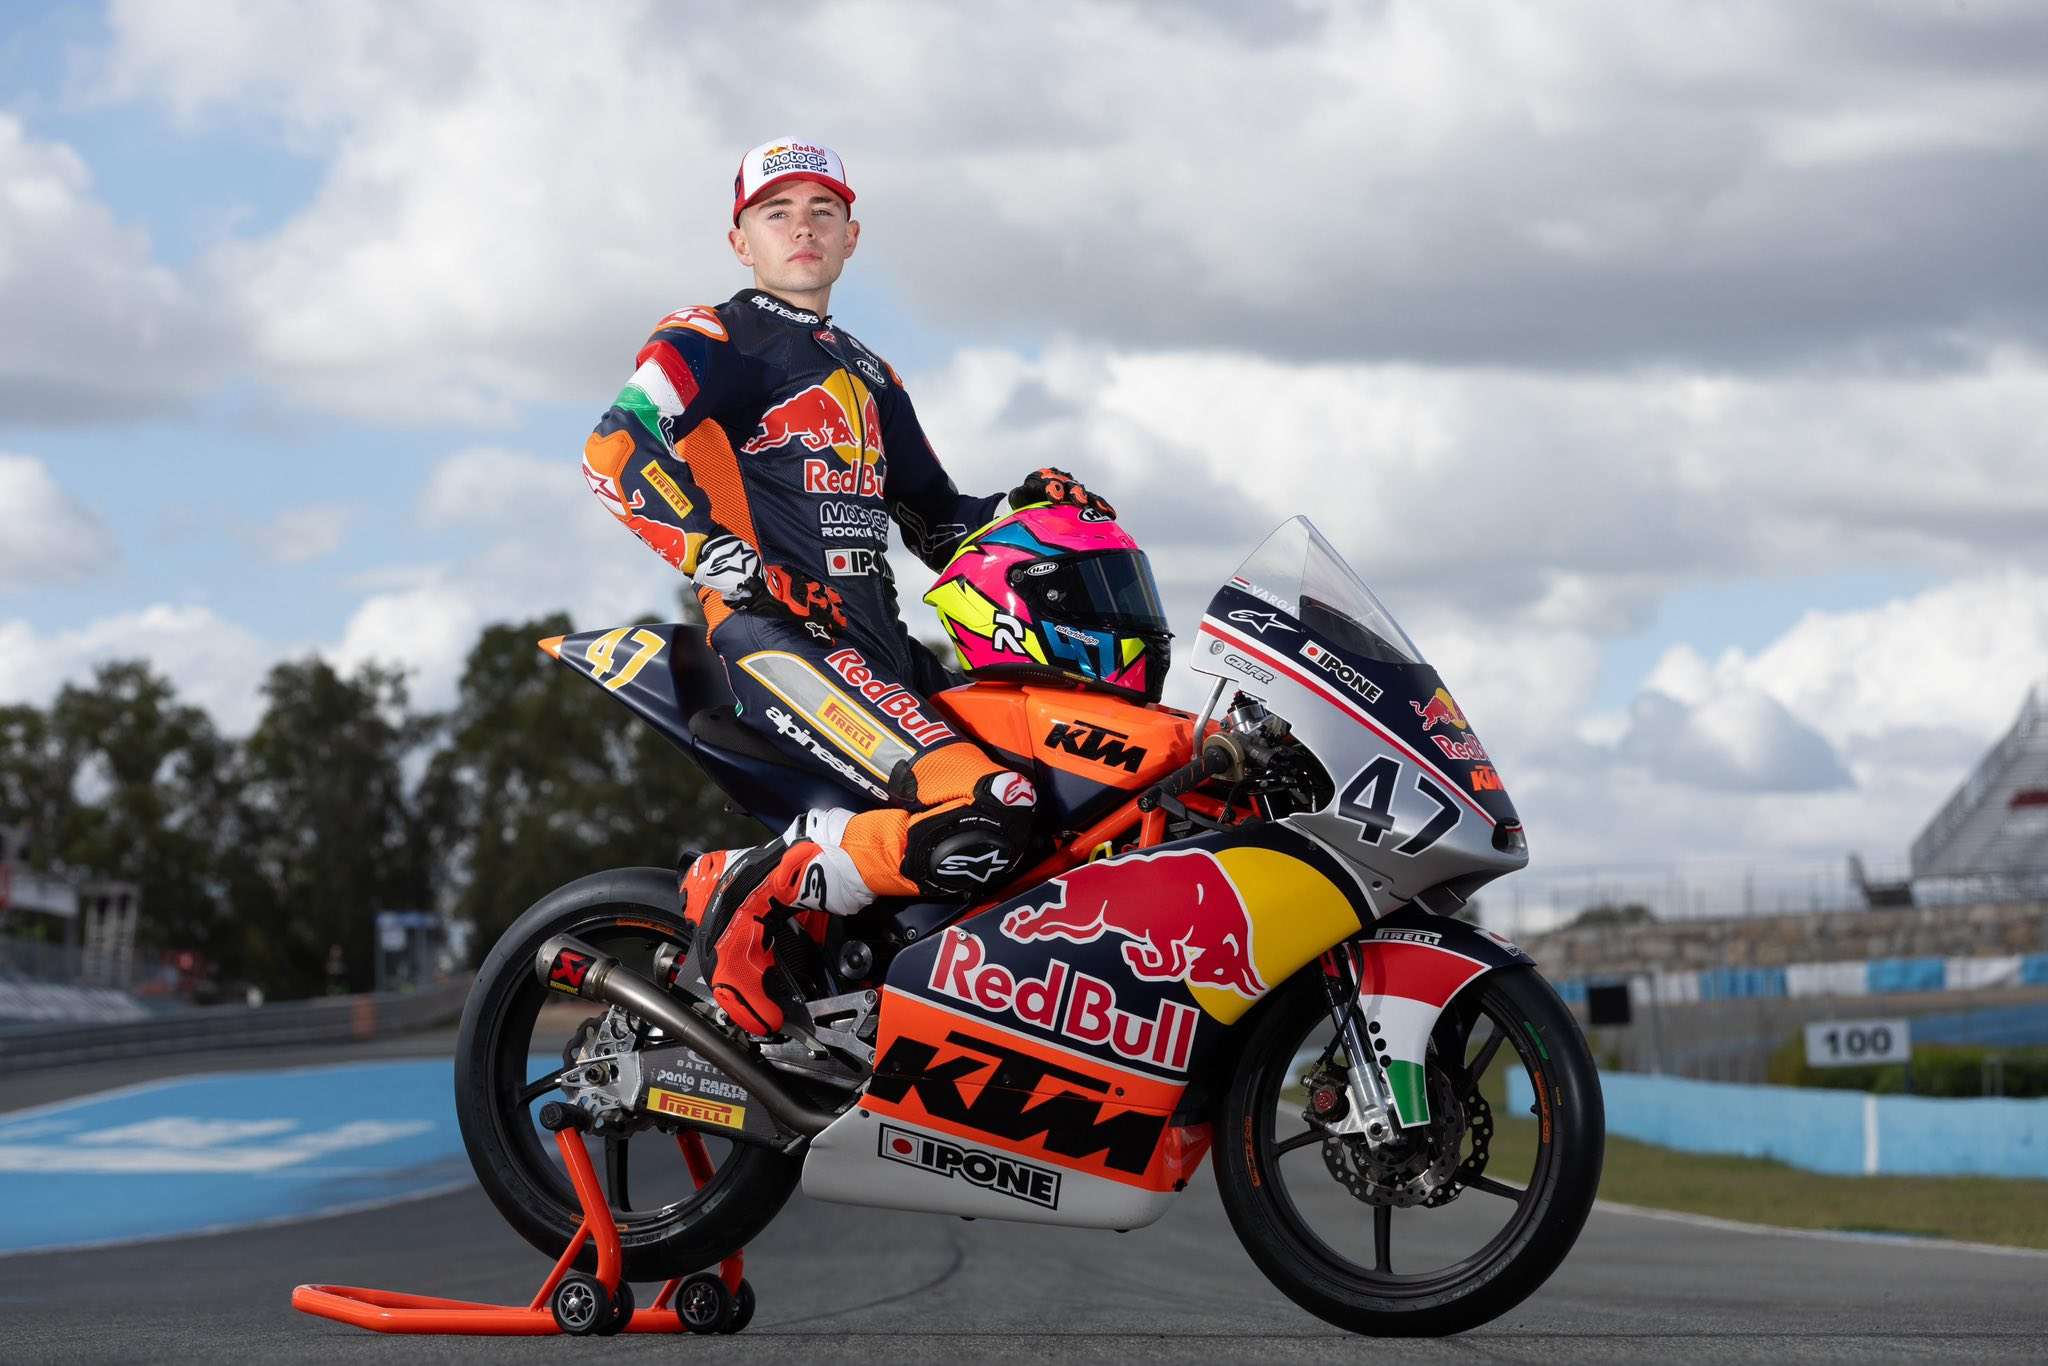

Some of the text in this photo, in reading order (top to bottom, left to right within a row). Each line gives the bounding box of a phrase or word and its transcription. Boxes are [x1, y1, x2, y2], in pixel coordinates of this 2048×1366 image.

[762, 150, 827, 171] MotoGP
[792, 143, 825, 156] Red Bull
[763, 164, 829, 176] ROOKIES CUP
[751, 295, 819, 324] alpinestars
[858, 360, 885, 384] HJC
[647, 466, 689, 512] PIRELLI
[804, 458, 887, 499] Red Bu
[1030, 563, 1057, 575] HJC
[1251, 584, 1298, 617] VARGA
[585, 626, 667, 692] 47
[1224, 653, 1275, 685] GALFER
[1316, 652, 1382, 702] IPONE
[824, 648, 956, 747] Red Bull
[823, 702, 876, 750] PIRELLI
[765, 706, 890, 801] alpinestars
[1044, 719, 1148, 774] KTM
[1335, 754, 1464, 857] 47
[1375, 928, 1442, 946] PIRELLI
[928, 925, 1200, 1073] Red Bull
[1822, 1027, 1892, 1057] 100
[656, 1069, 696, 1086] panta
[676, 1059, 725, 1076] OAKLE
[699, 1086, 748, 1101] EUROPE
[700, 1078, 748, 1095] PARTS
[658, 1092, 733, 1125] PIRELLI
[867, 1030, 1168, 1177] KTM
[920, 1140, 1054, 1202] IPONE
